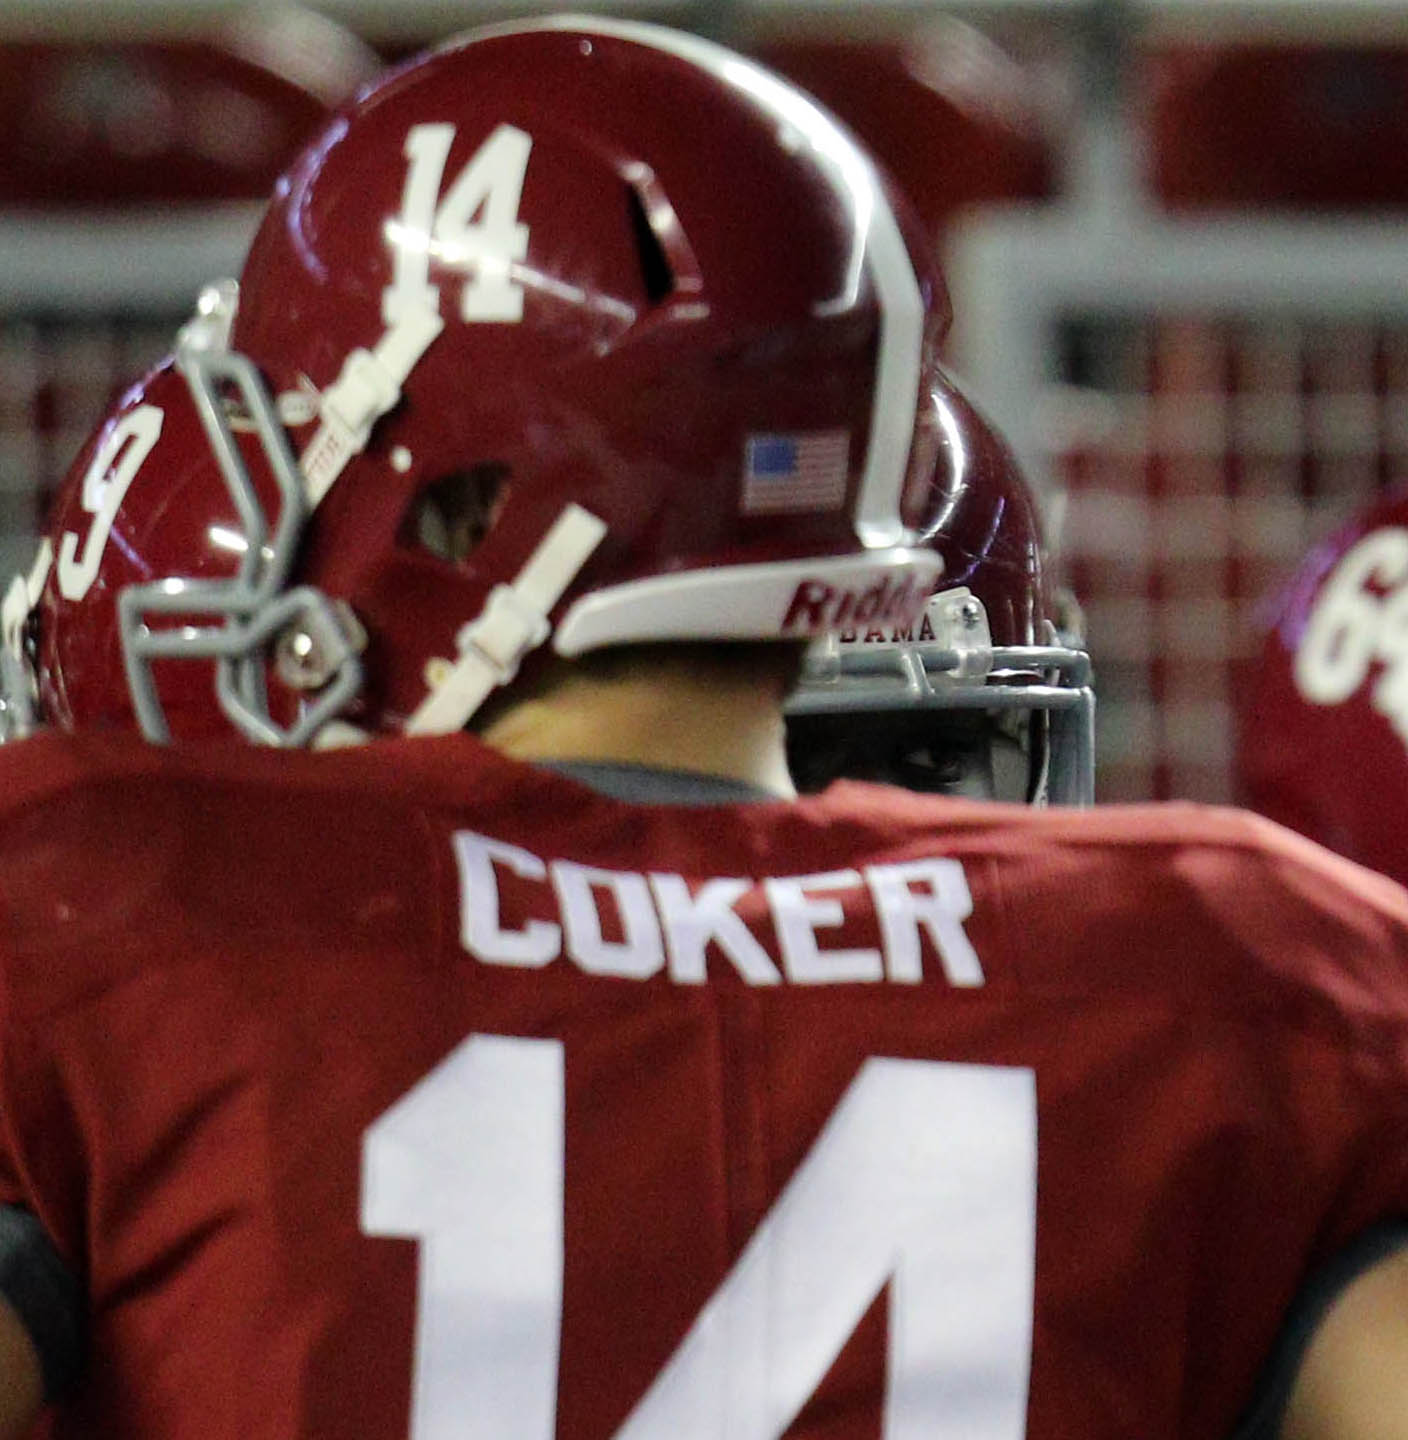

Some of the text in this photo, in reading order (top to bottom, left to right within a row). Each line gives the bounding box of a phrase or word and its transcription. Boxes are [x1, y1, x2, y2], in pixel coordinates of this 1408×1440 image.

[382, 123, 533, 323] 14
[57, 404, 165, 601] 9
[452, 828, 985, 988] COKER
